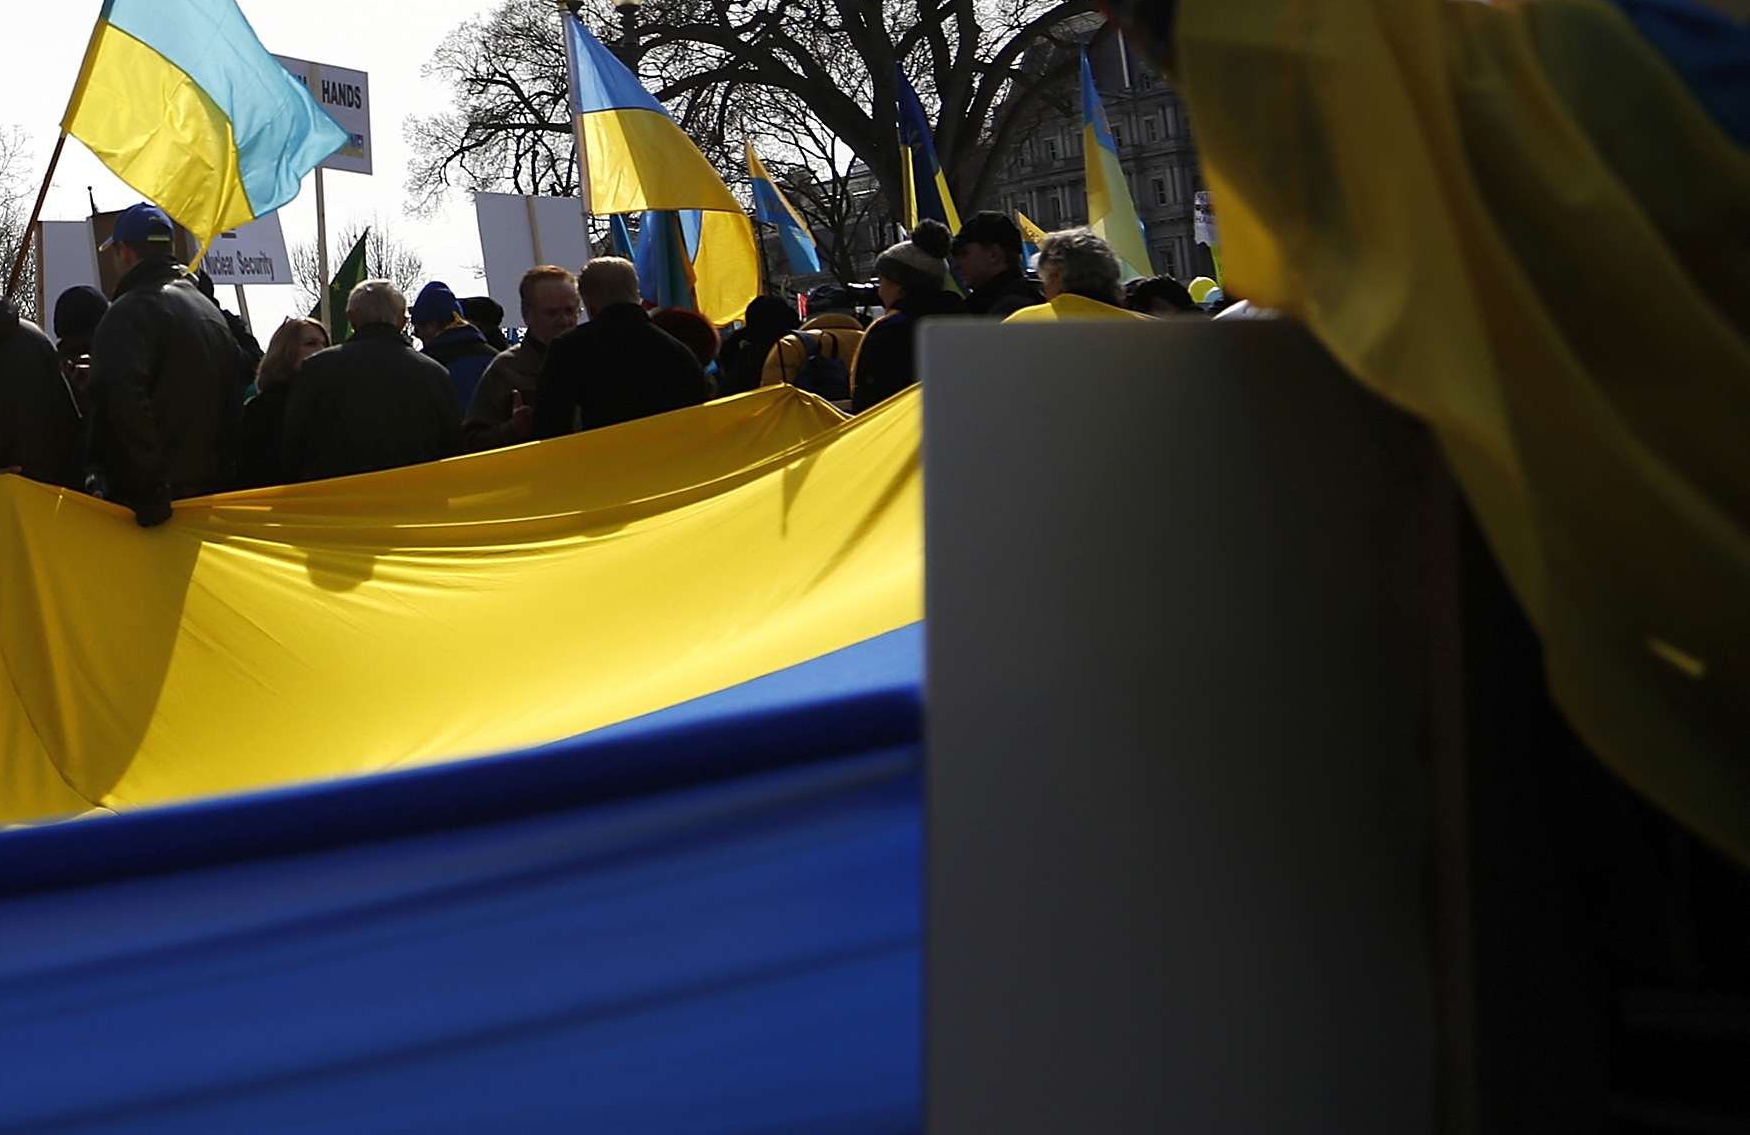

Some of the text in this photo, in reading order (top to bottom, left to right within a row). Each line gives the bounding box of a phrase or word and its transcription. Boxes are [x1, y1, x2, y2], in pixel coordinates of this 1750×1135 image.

[321, 79, 362, 110] HANDS
[202, 250, 275, 282] Nuclear Security
